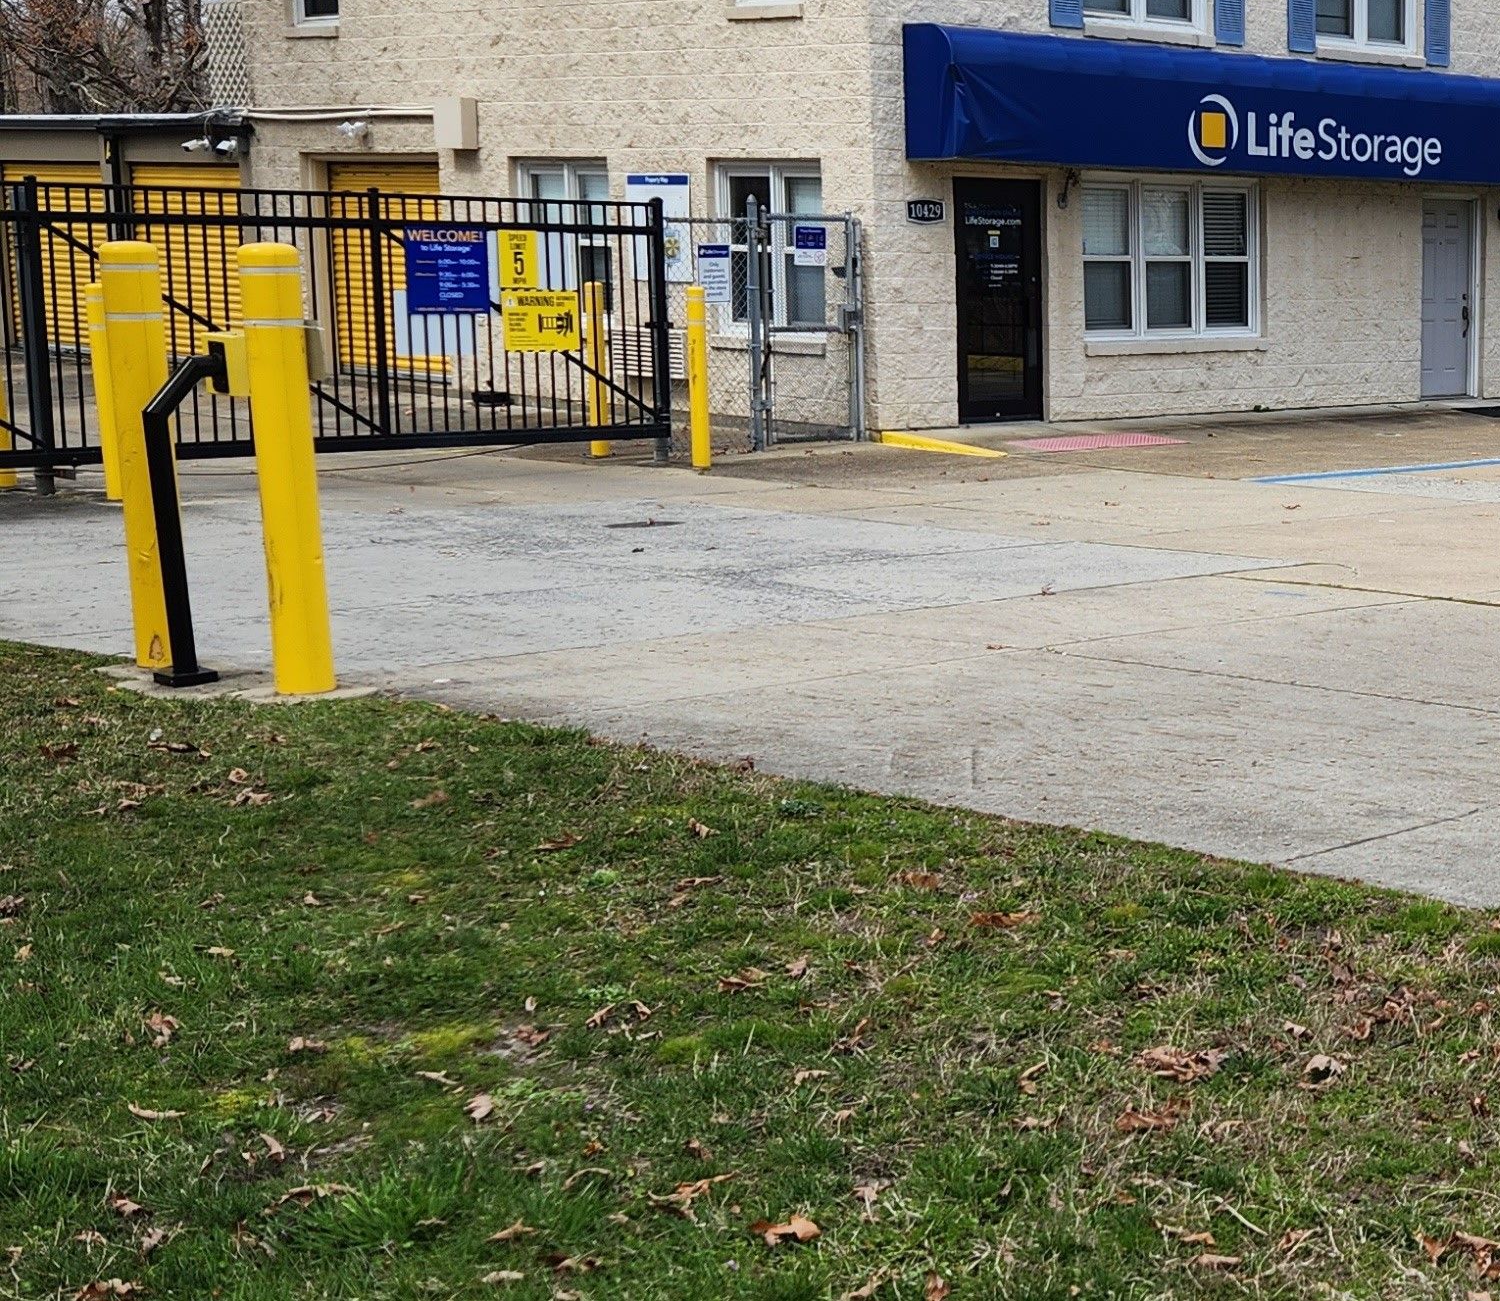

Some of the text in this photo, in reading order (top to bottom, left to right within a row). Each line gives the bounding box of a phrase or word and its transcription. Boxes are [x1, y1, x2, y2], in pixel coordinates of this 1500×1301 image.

[1247, 111, 1442, 177] LifeStorage
[909, 203, 941, 218] 10429
[965, 215, 1022, 227] LifeStorage.com
[406, 229, 484, 243] WELCOME!
[508, 233, 527, 241] SPEED
[430, 243, 443, 252] Life
[444, 243, 471, 254] Storage
[510, 242, 526, 250] LIMIT
[513, 251, 525, 275] 5
[513, 277, 527, 285] MPH
[517, 295, 555, 307] WARNING
